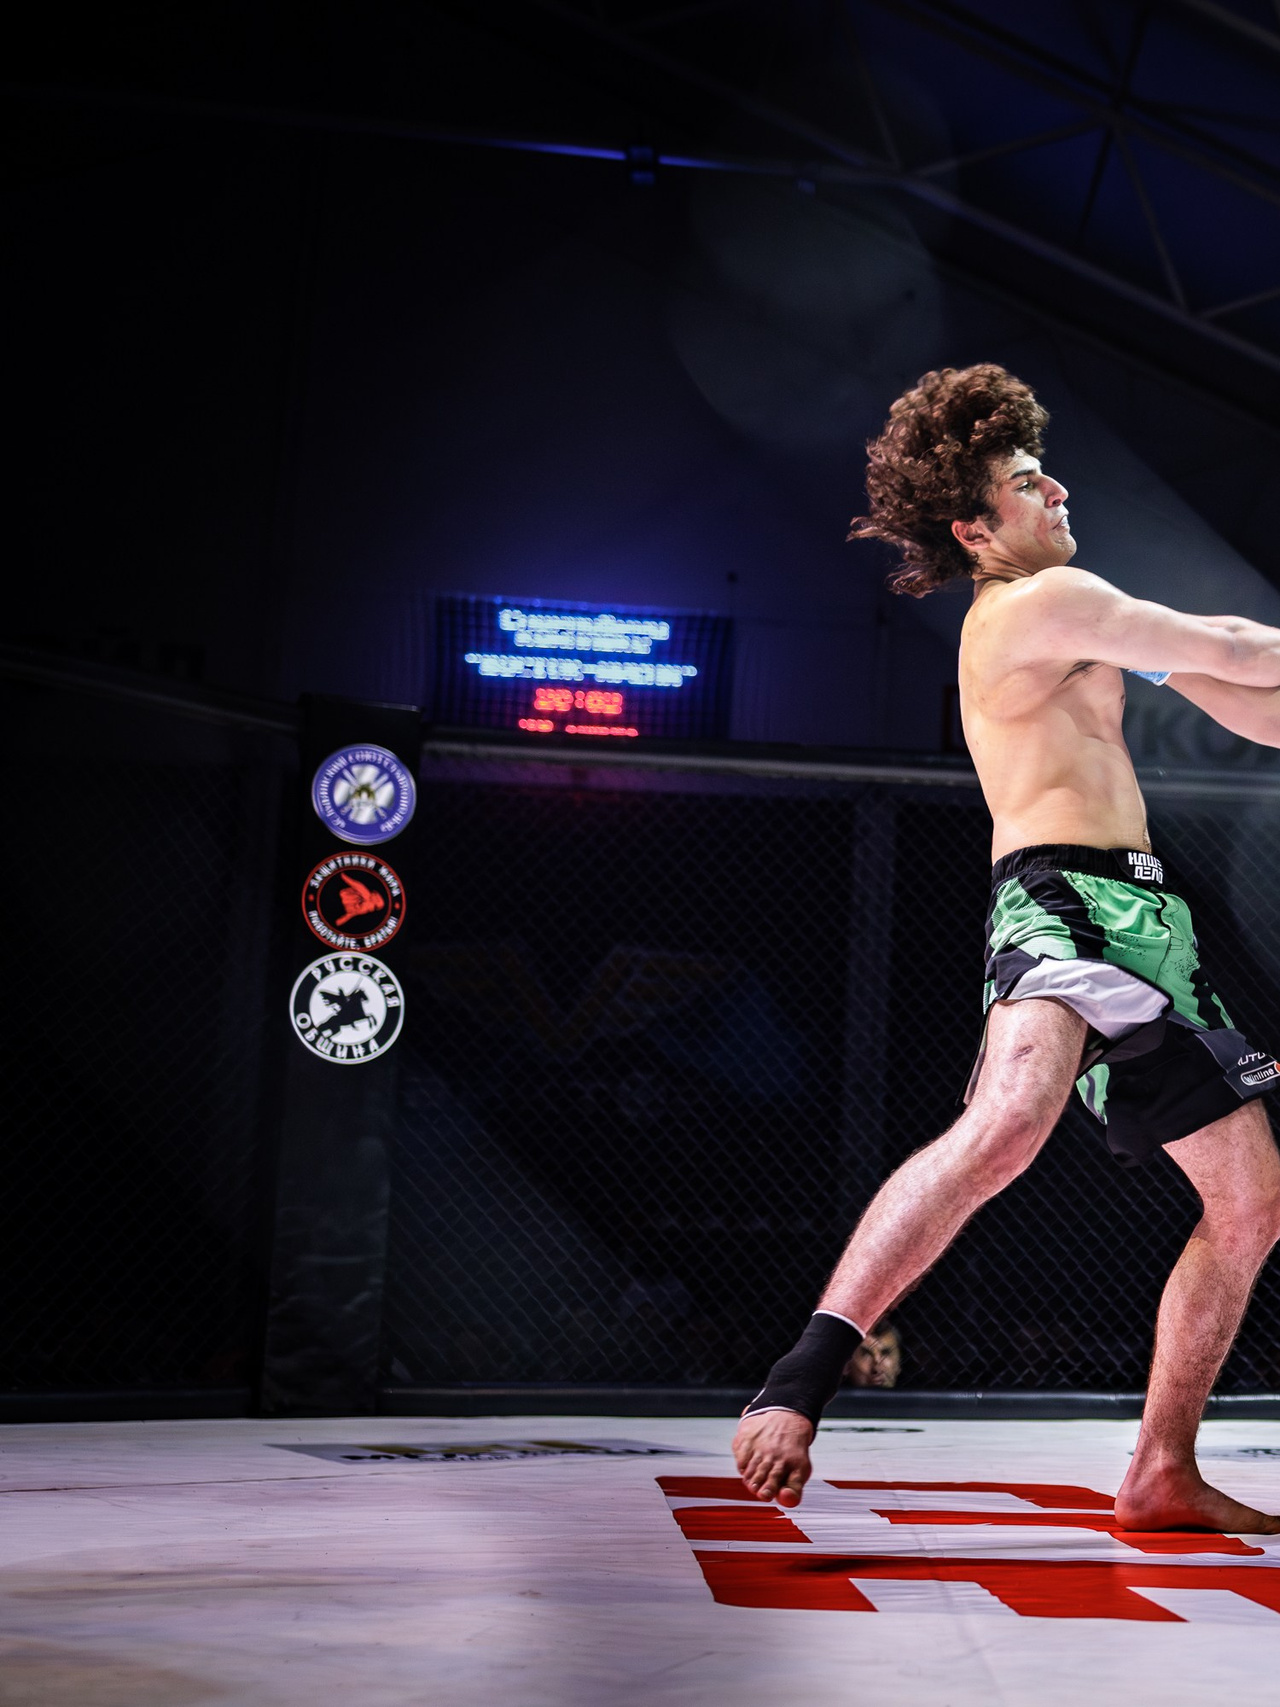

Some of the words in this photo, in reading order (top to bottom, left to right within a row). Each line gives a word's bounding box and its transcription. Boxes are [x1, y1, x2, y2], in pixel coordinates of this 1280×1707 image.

[311, 957, 400, 1008] РУССКАЯ
[296, 1012, 379, 1059] ОБЩИНА
[1243, 1068, 1274, 1084] Winline
